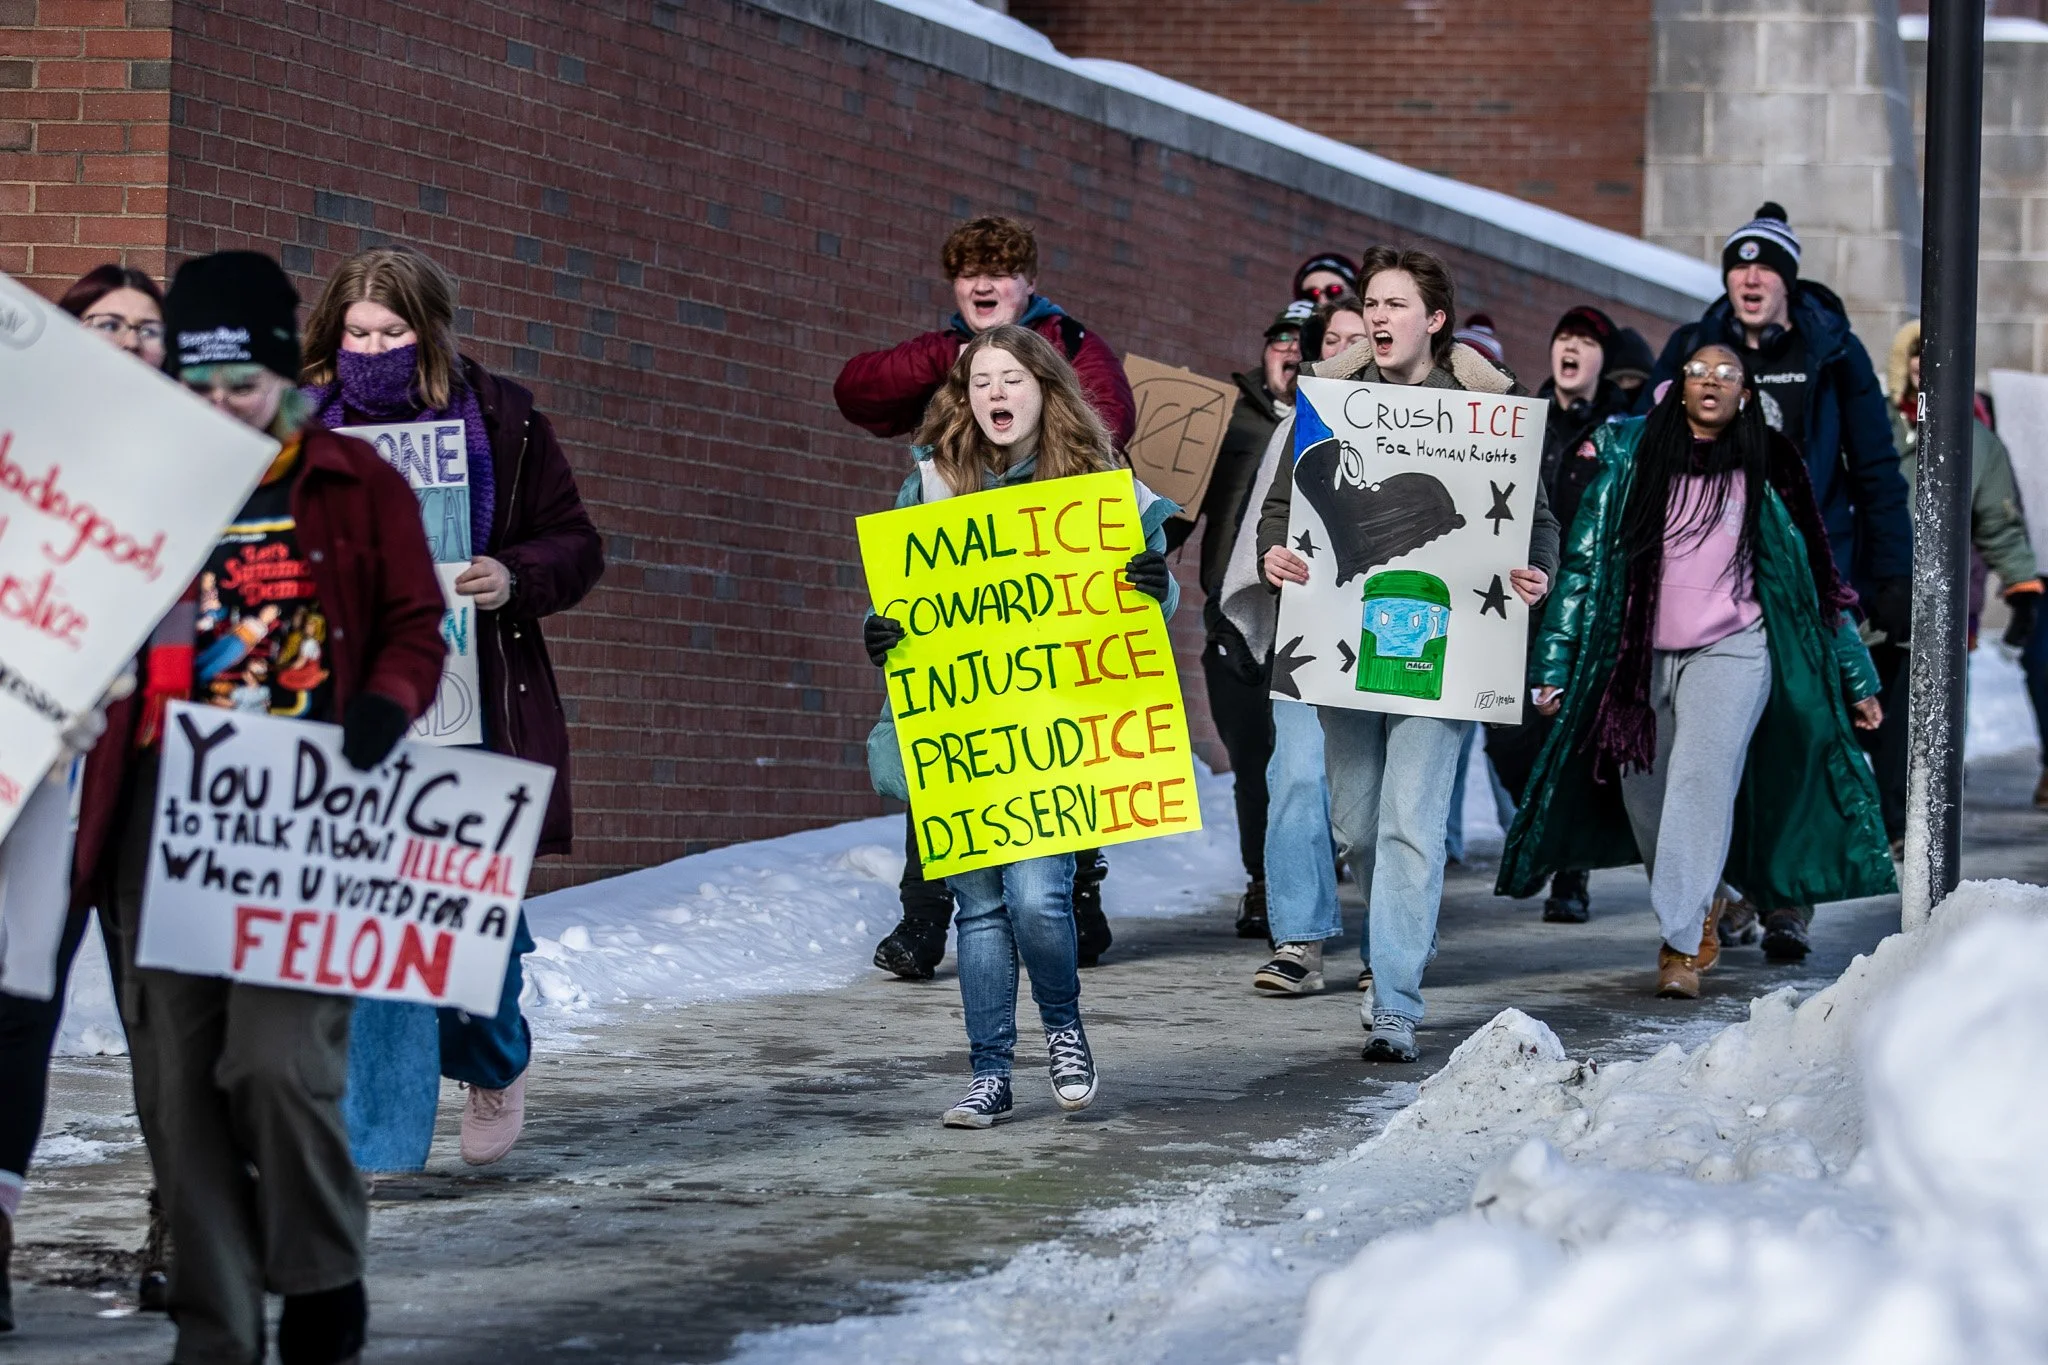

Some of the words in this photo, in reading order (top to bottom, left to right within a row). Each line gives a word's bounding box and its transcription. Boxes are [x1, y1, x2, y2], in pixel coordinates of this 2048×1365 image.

[1467, 401, 1529, 438] ICE
[905, 497, 1131, 578] MALICE
[890, 629, 1165, 719] INJUSTICE
[911, 703, 1176, 790] PREJUDICE
[165, 797, 200, 836] to
[213, 812, 295, 849] TALK
[294, 738, 415, 827] Don't
[405, 770, 532, 853] Get
[921, 778, 1188, 862] DISSERVICE
[161, 841, 282, 898] When
[478, 904, 508, 938] A
[232, 904, 456, 999] FELON
